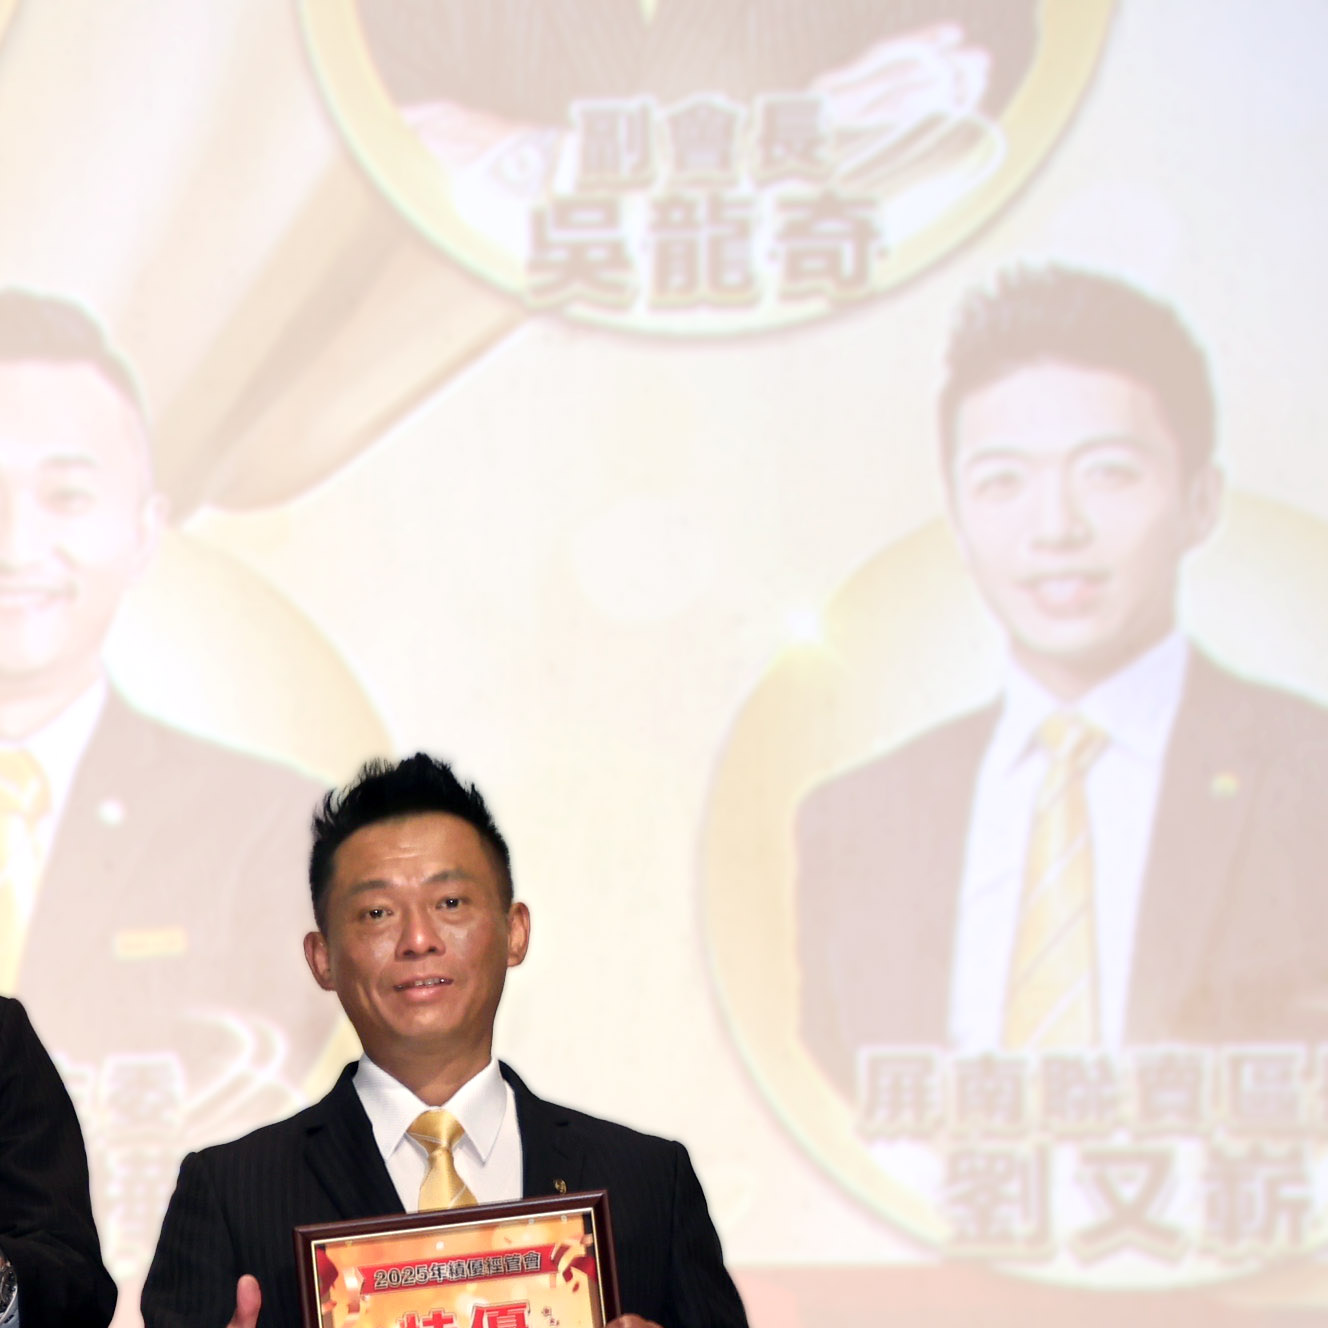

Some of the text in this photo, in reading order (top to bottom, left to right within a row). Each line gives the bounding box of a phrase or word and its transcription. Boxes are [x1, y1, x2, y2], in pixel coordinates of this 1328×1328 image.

[574, 97, 831, 188] 副會長
[527, 192, 884, 308] 吳龍奇
